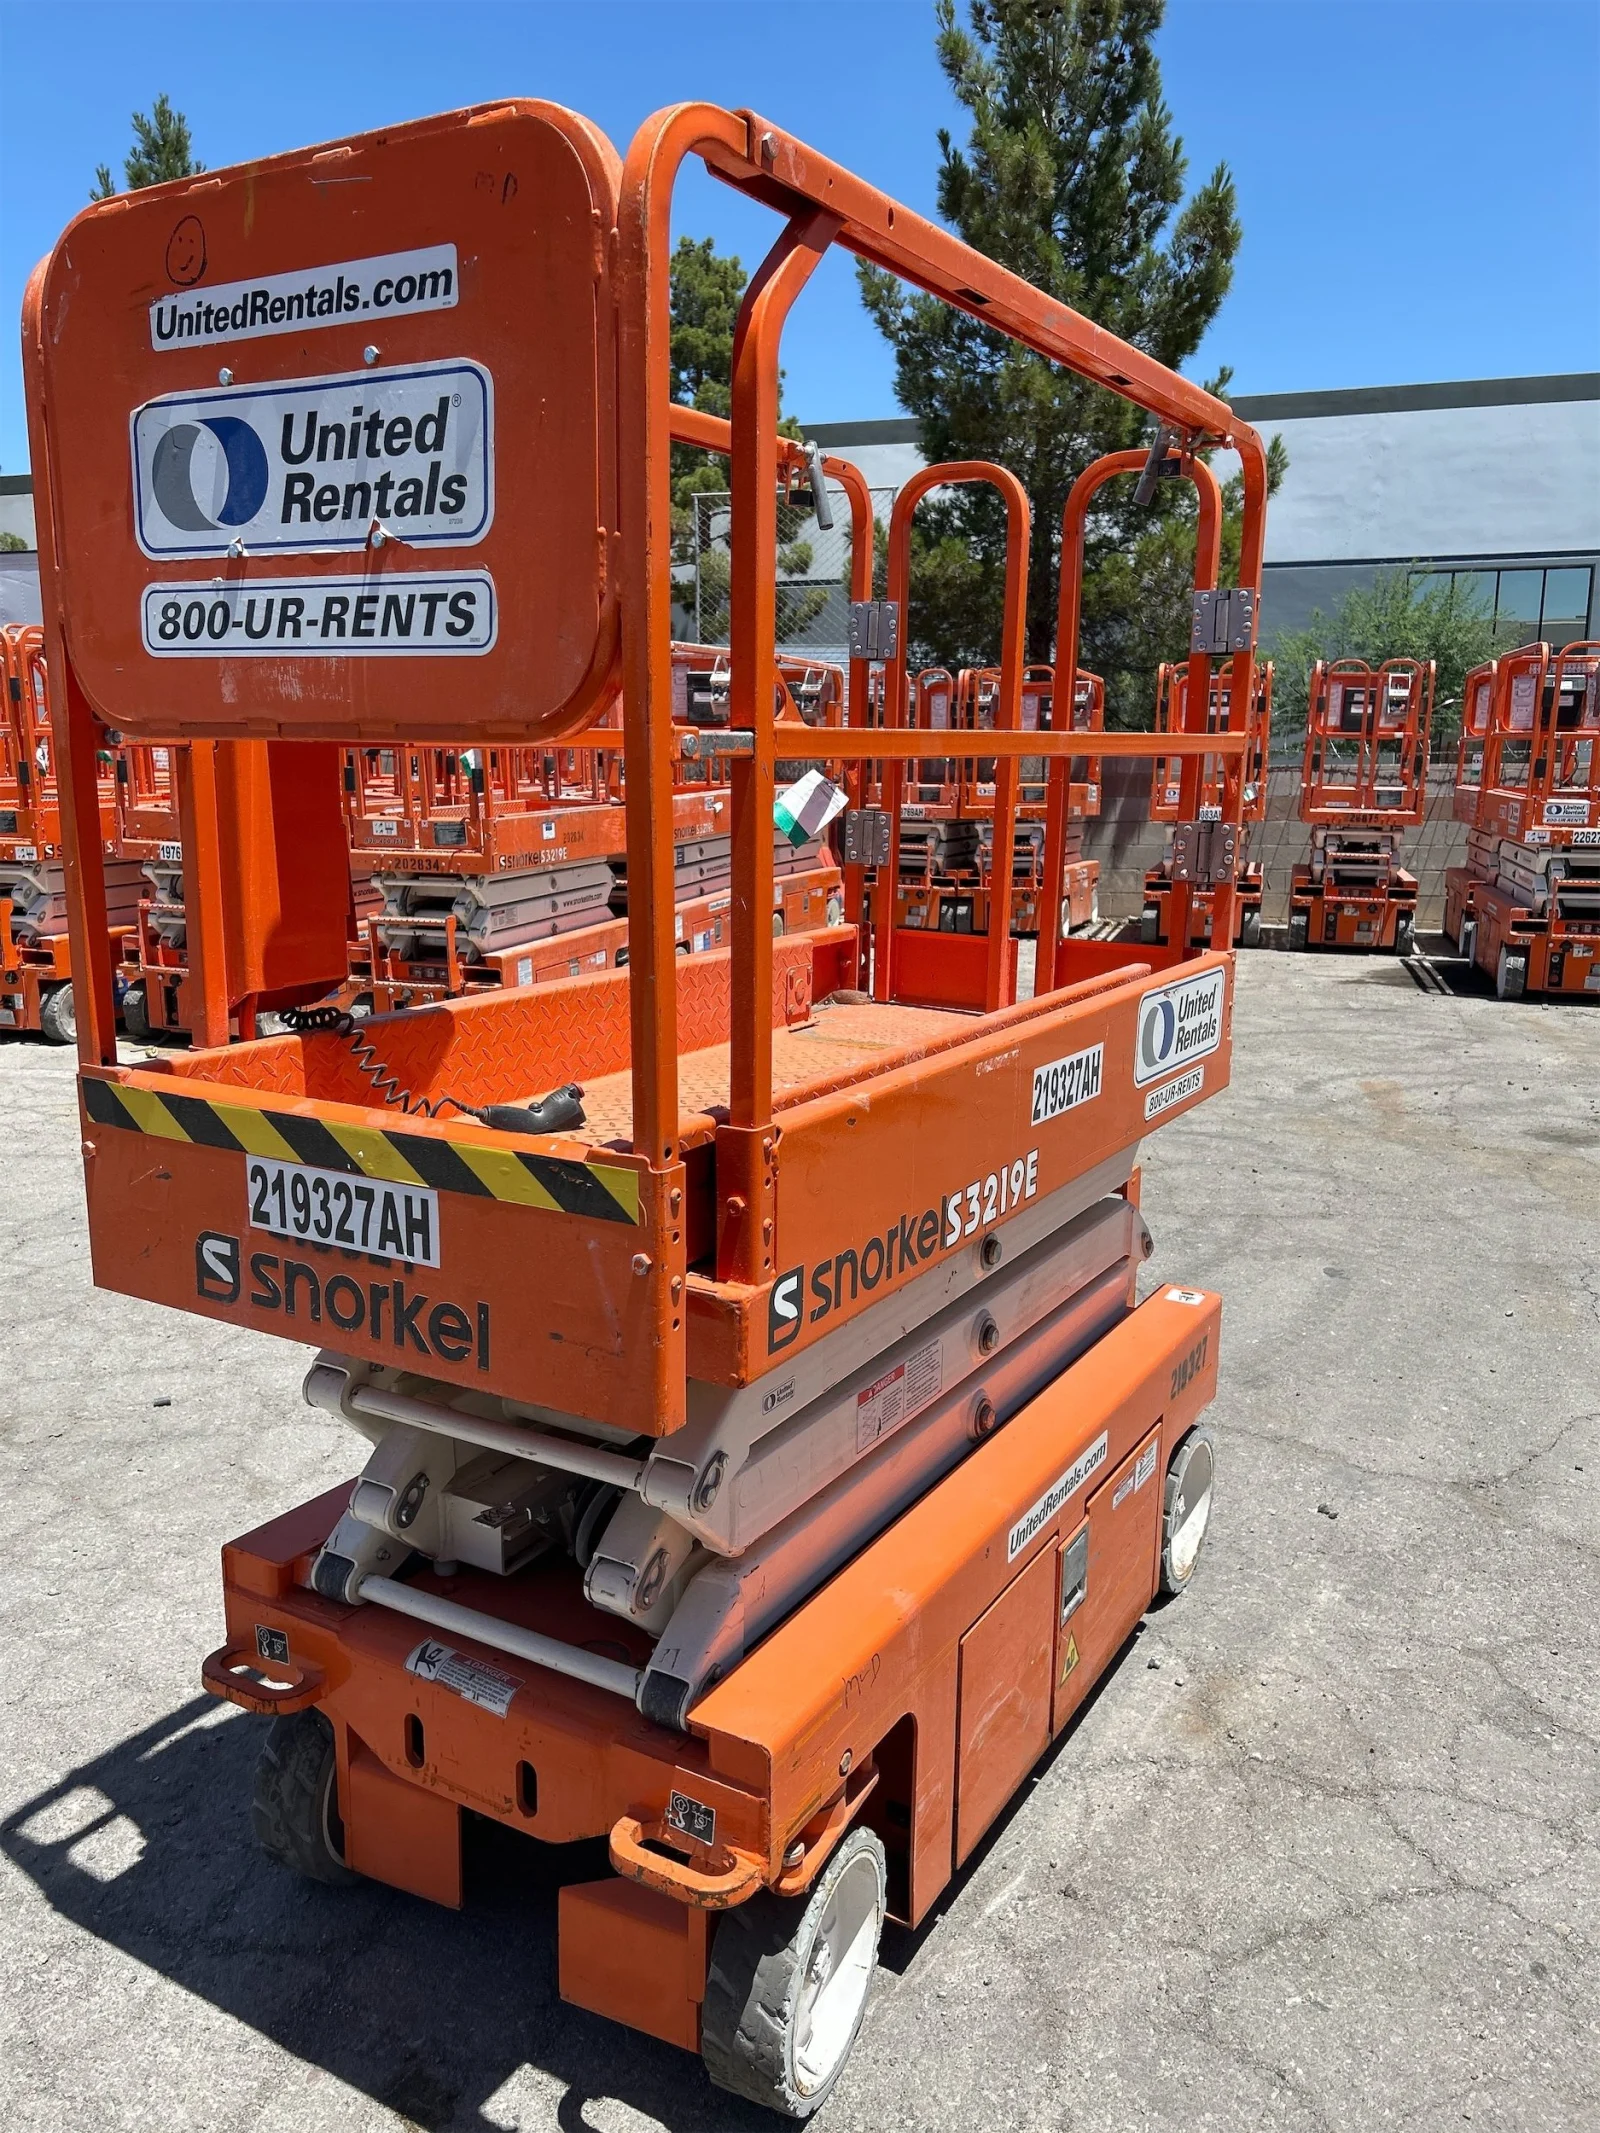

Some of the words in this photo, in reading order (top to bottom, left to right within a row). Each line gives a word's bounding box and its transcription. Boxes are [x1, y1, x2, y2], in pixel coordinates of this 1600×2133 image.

[155, 267, 454, 341] UnitedRentals.com
[280, 396, 451, 465] United
[280, 461, 468, 524] Rentals
[157, 591, 477, 641] 800-UR-RENTS
[394, 857, 440, 871] 202834
[1174, 1014, 1217, 1054] Rentals
[1178, 983, 1217, 1023] United
[1032, 1050, 1101, 1121] 219327AH
[1148, 1071, 1201, 1112] 800-UR-RENTS
[250, 1164, 431, 1260] 219327AH
[810, 1195, 947, 1323] snorkel
[945, 1148, 1039, 1250] S3219E
[250, 1252, 490, 1371] snorkel
[1010, 1442, 1106, 1554] UnitedRentals.com
[472, 1661, 510, 1682] DANGER
